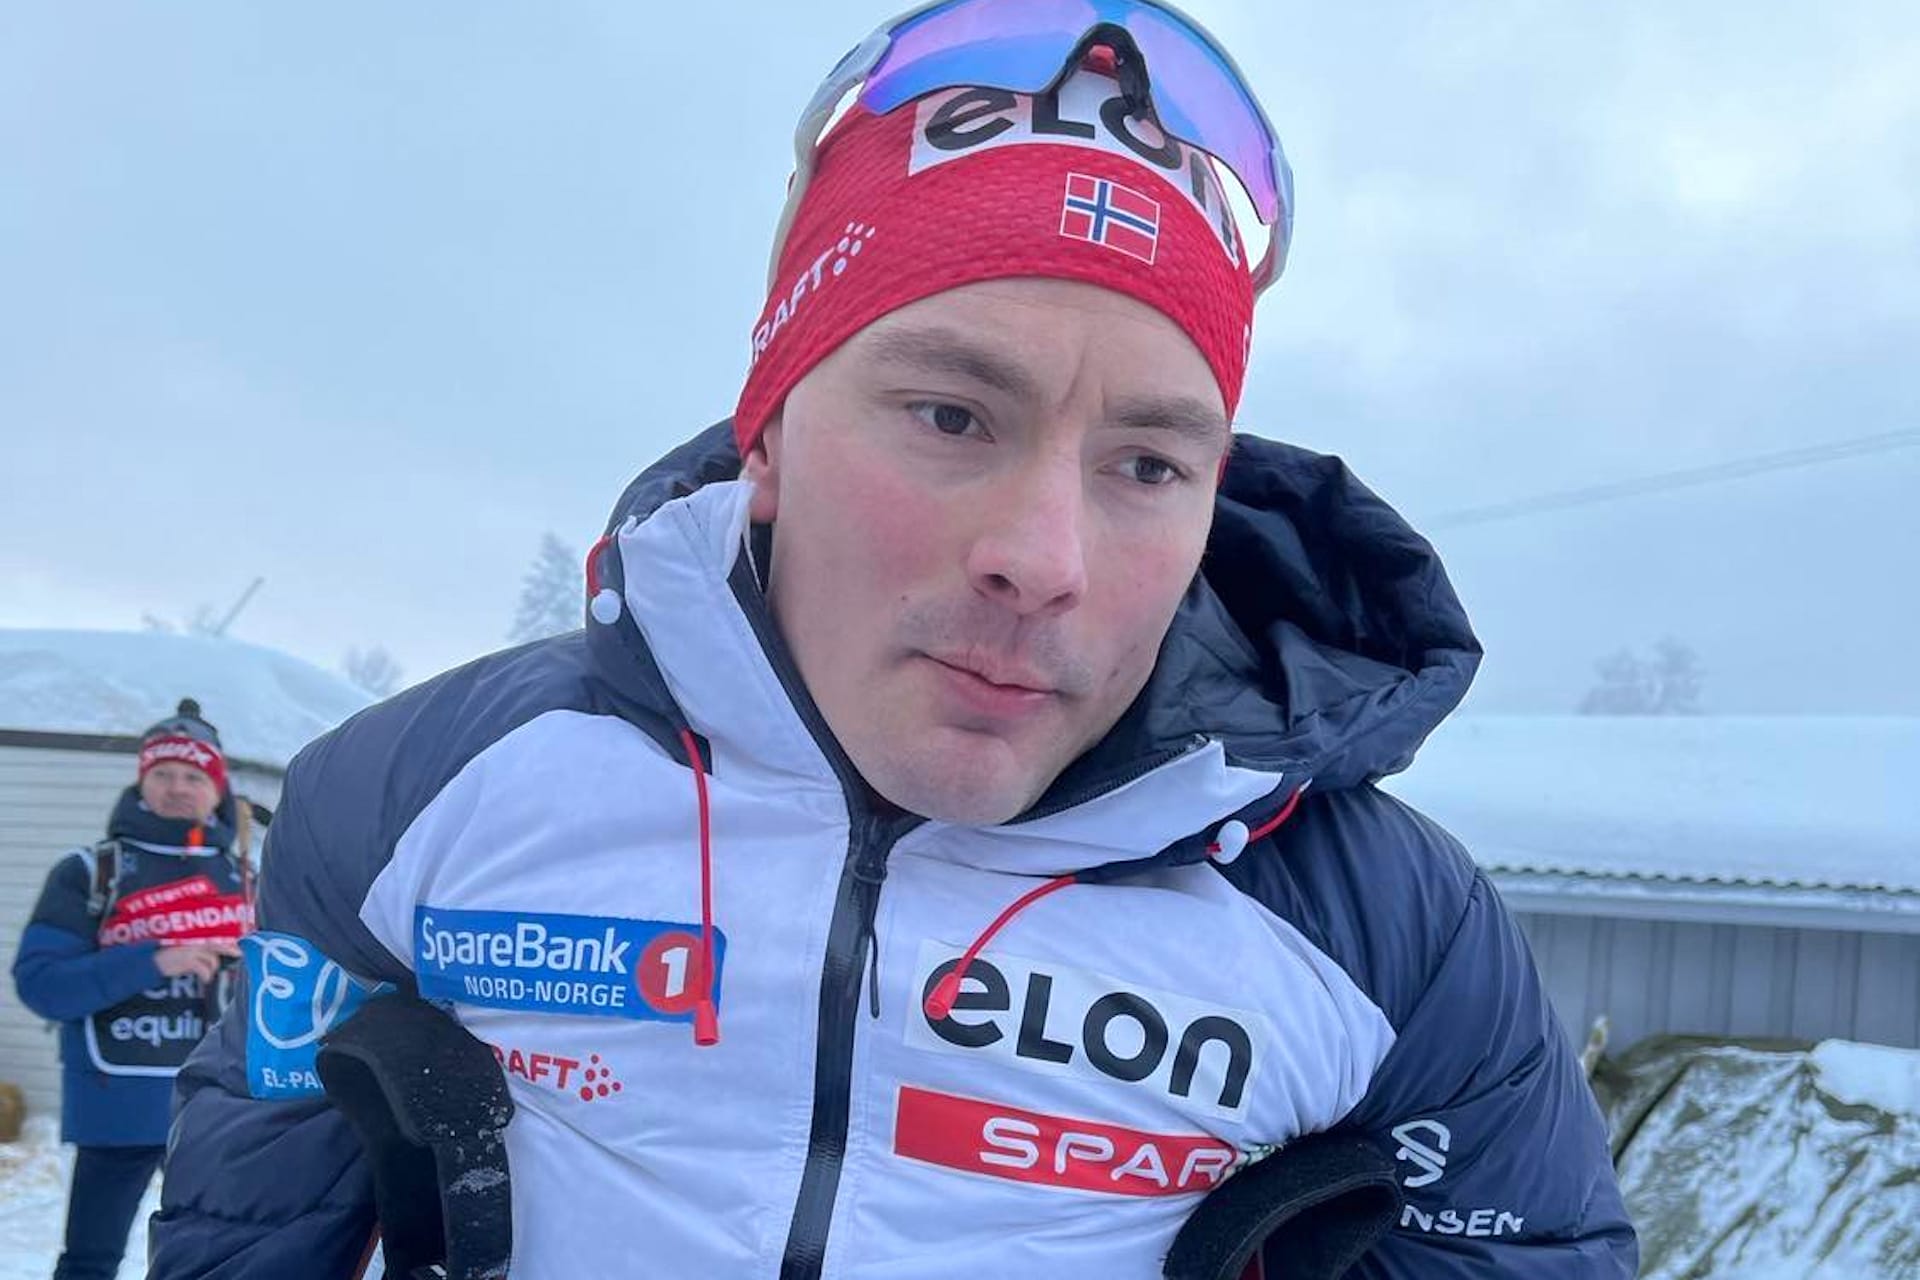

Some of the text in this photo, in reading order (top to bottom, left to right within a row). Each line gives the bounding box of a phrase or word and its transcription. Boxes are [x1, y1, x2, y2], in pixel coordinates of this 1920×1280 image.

[754, 247, 835, 364] RAFT
[422, 916, 690, 998] SpareBank 1
[464, 975, 626, 1008] NORD-NORGE
[262, 1067, 323, 1089] EL-PA
[979, 1116, 1232, 1189] SPAR
[1400, 1203, 1524, 1237] NSEN
